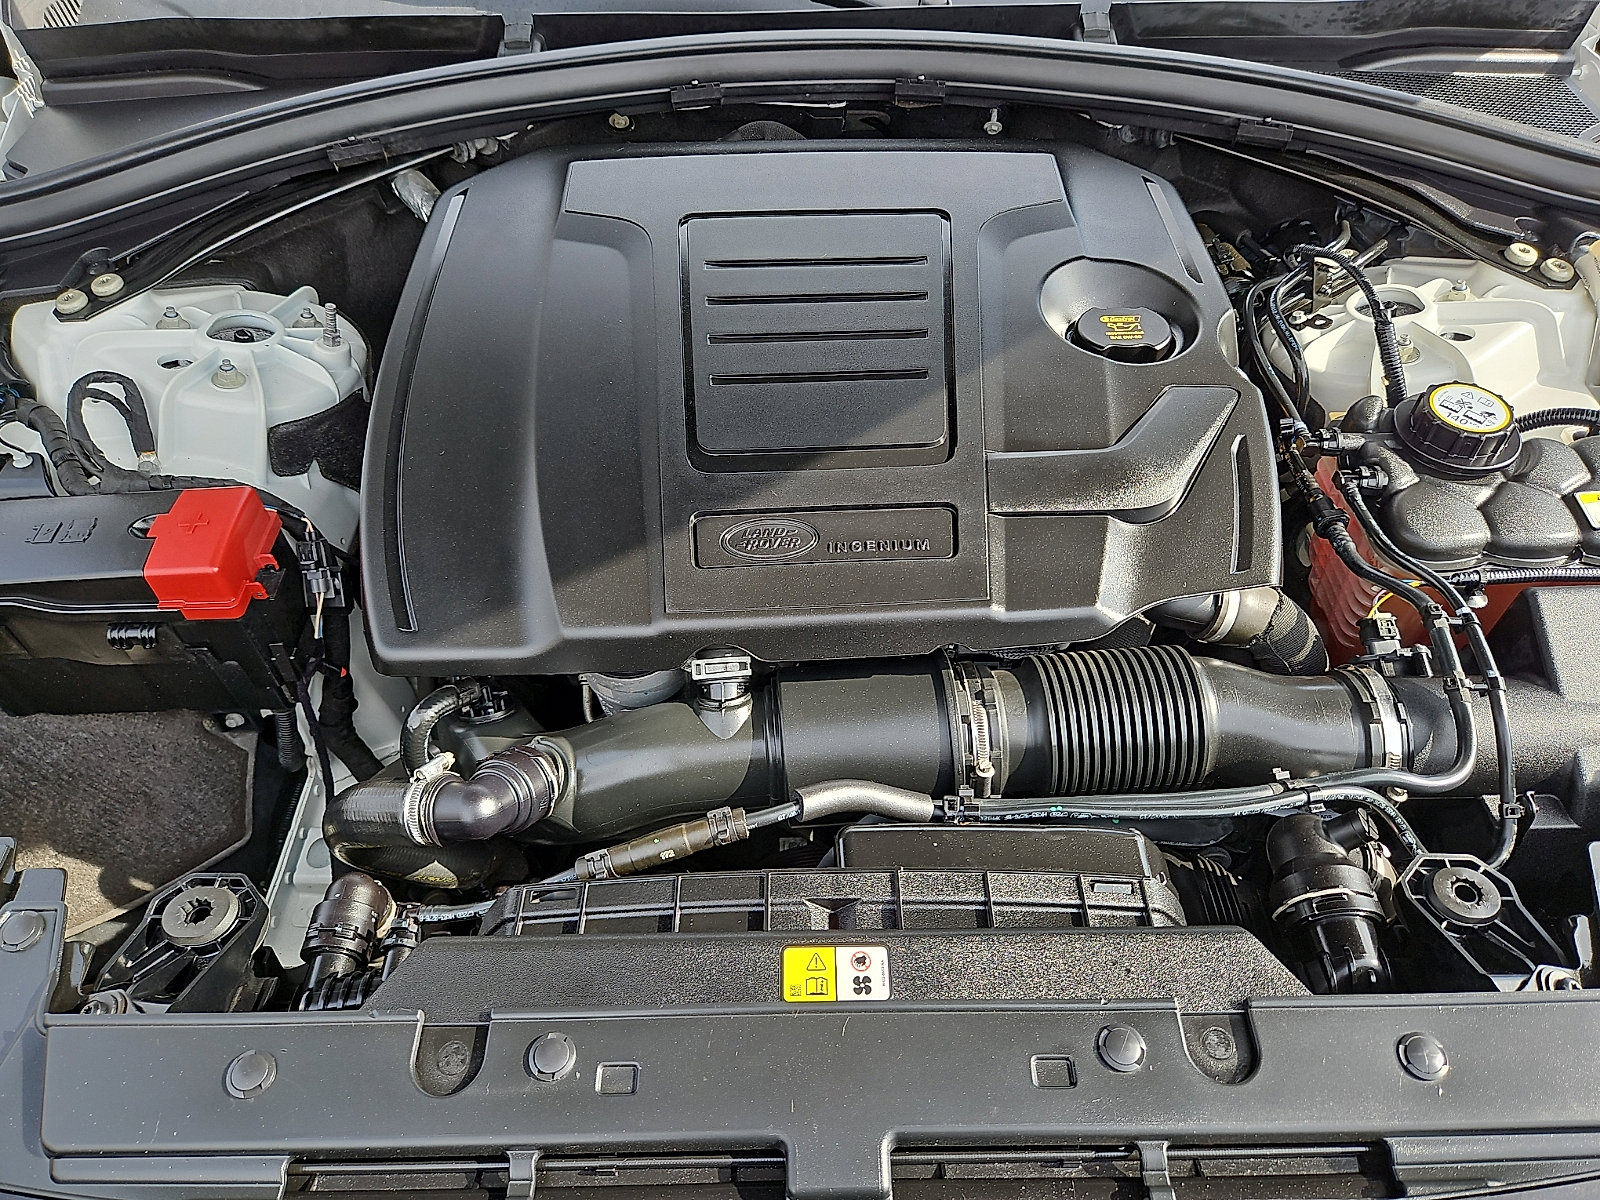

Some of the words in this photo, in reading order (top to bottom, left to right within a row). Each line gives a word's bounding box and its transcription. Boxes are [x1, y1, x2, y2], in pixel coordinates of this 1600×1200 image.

[1446, 412, 1469, 426] 140
[741, 527, 787, 539] LAND
[744, 537, 801, 551] ROVER
[827, 538, 931, 554] INGENIUM
